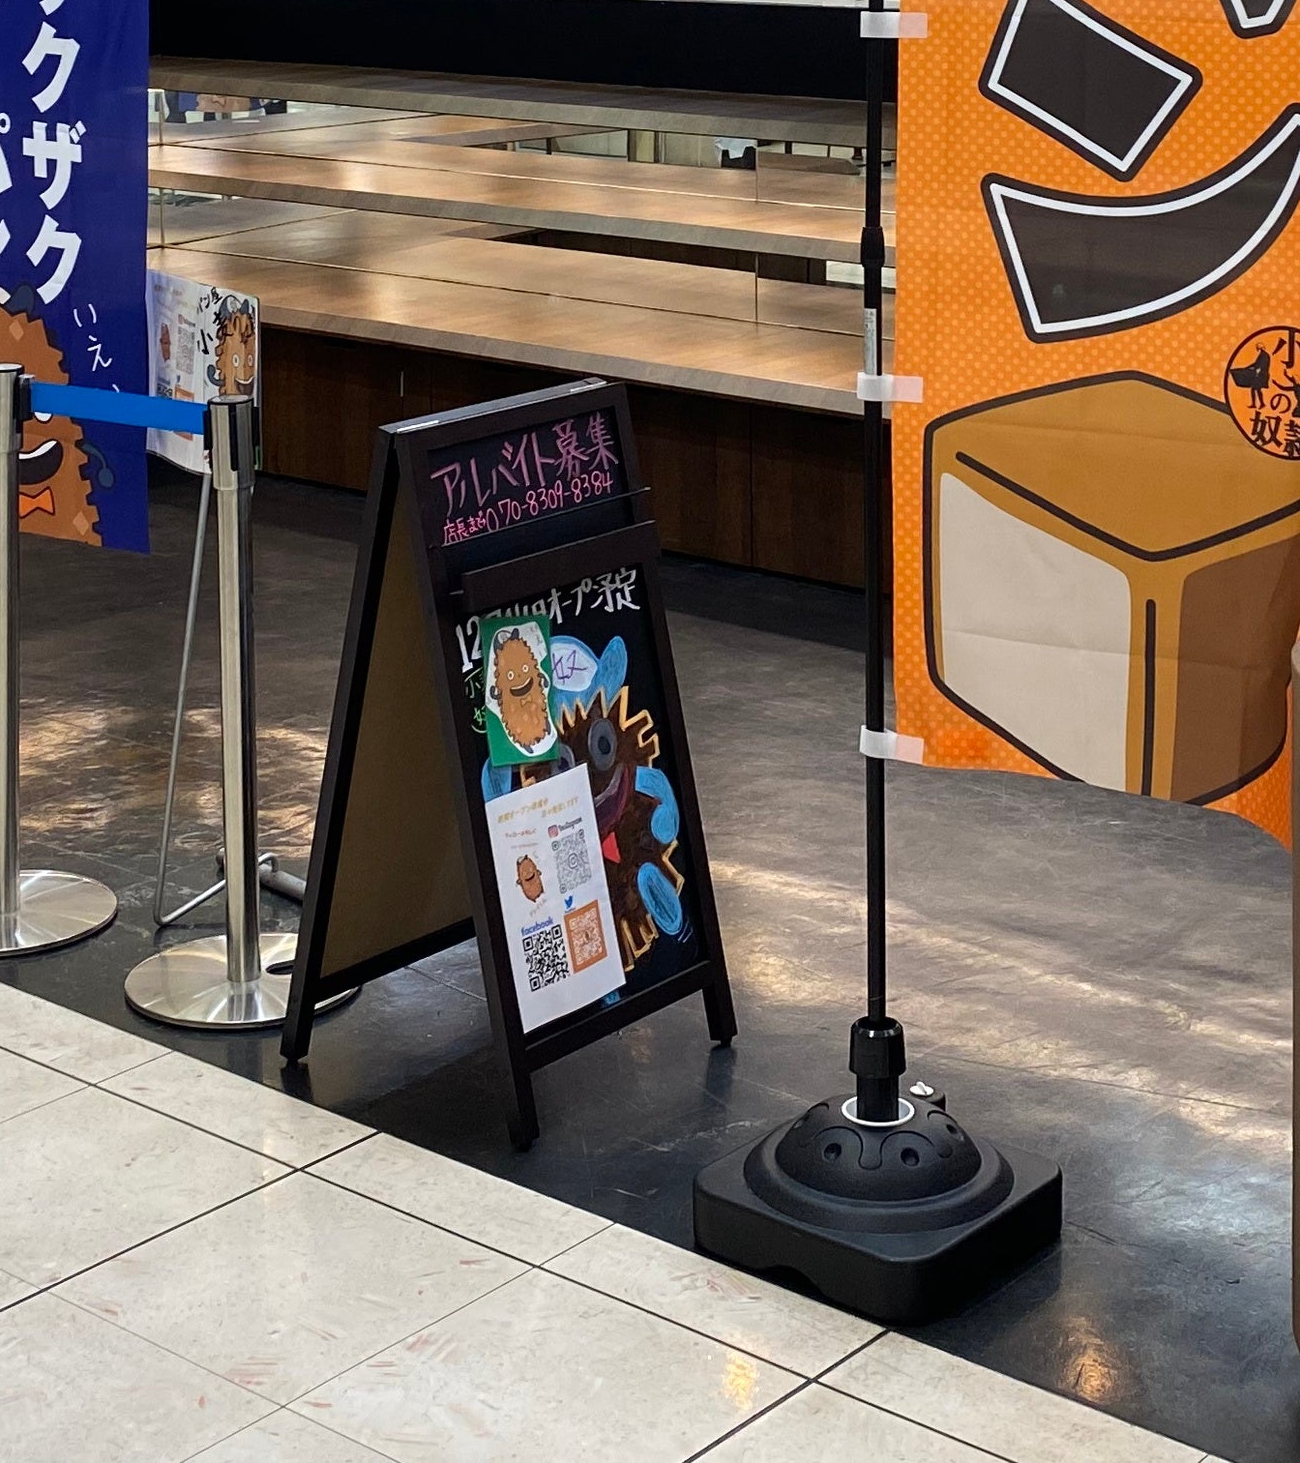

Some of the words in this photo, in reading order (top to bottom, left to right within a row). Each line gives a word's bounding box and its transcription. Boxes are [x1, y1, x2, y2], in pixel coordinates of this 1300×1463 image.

[430, 411, 619, 517] アルバイト募集
[521, 917, 554, 936] facebook
